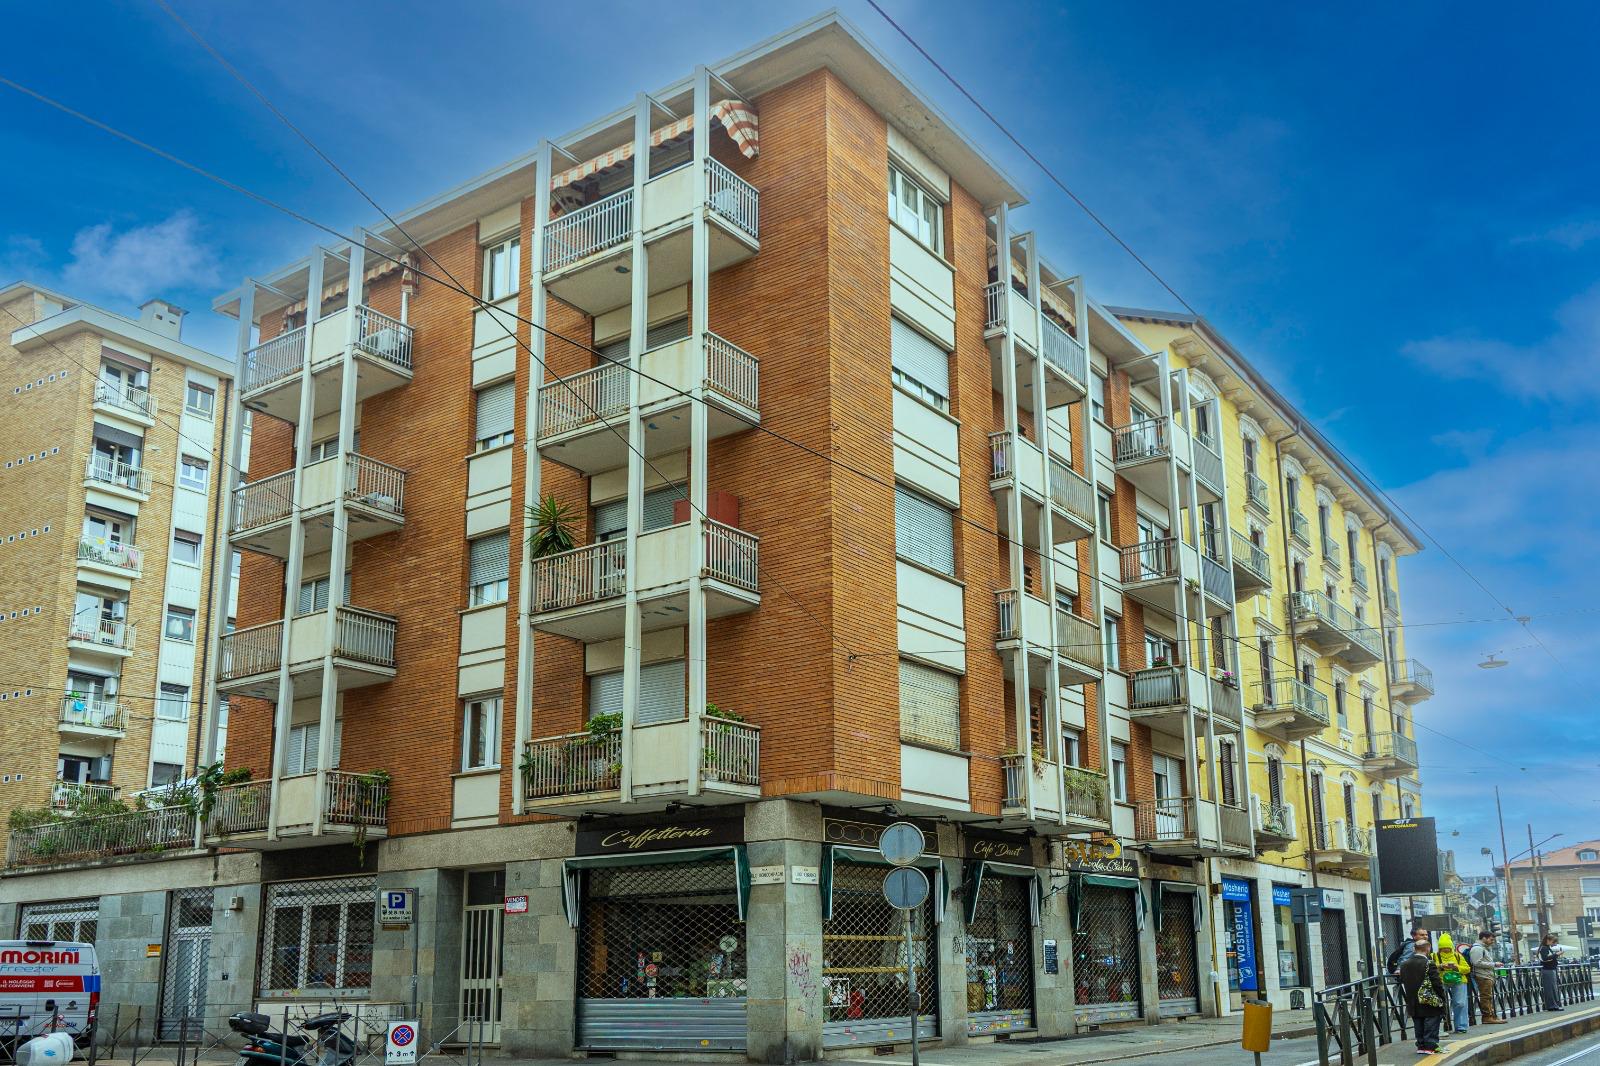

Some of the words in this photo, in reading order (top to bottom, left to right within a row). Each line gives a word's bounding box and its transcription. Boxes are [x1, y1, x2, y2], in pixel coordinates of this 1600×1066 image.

[601, 826, 713, 849] Caffetteria
[1222, 882, 1249, 894] Washeria
[1272, 888, 1291, 899] Washer
[391, 893, 403, 908] P
[1, 951, 79, 964] MORINI
[0, 965, 58, 973] freezer
